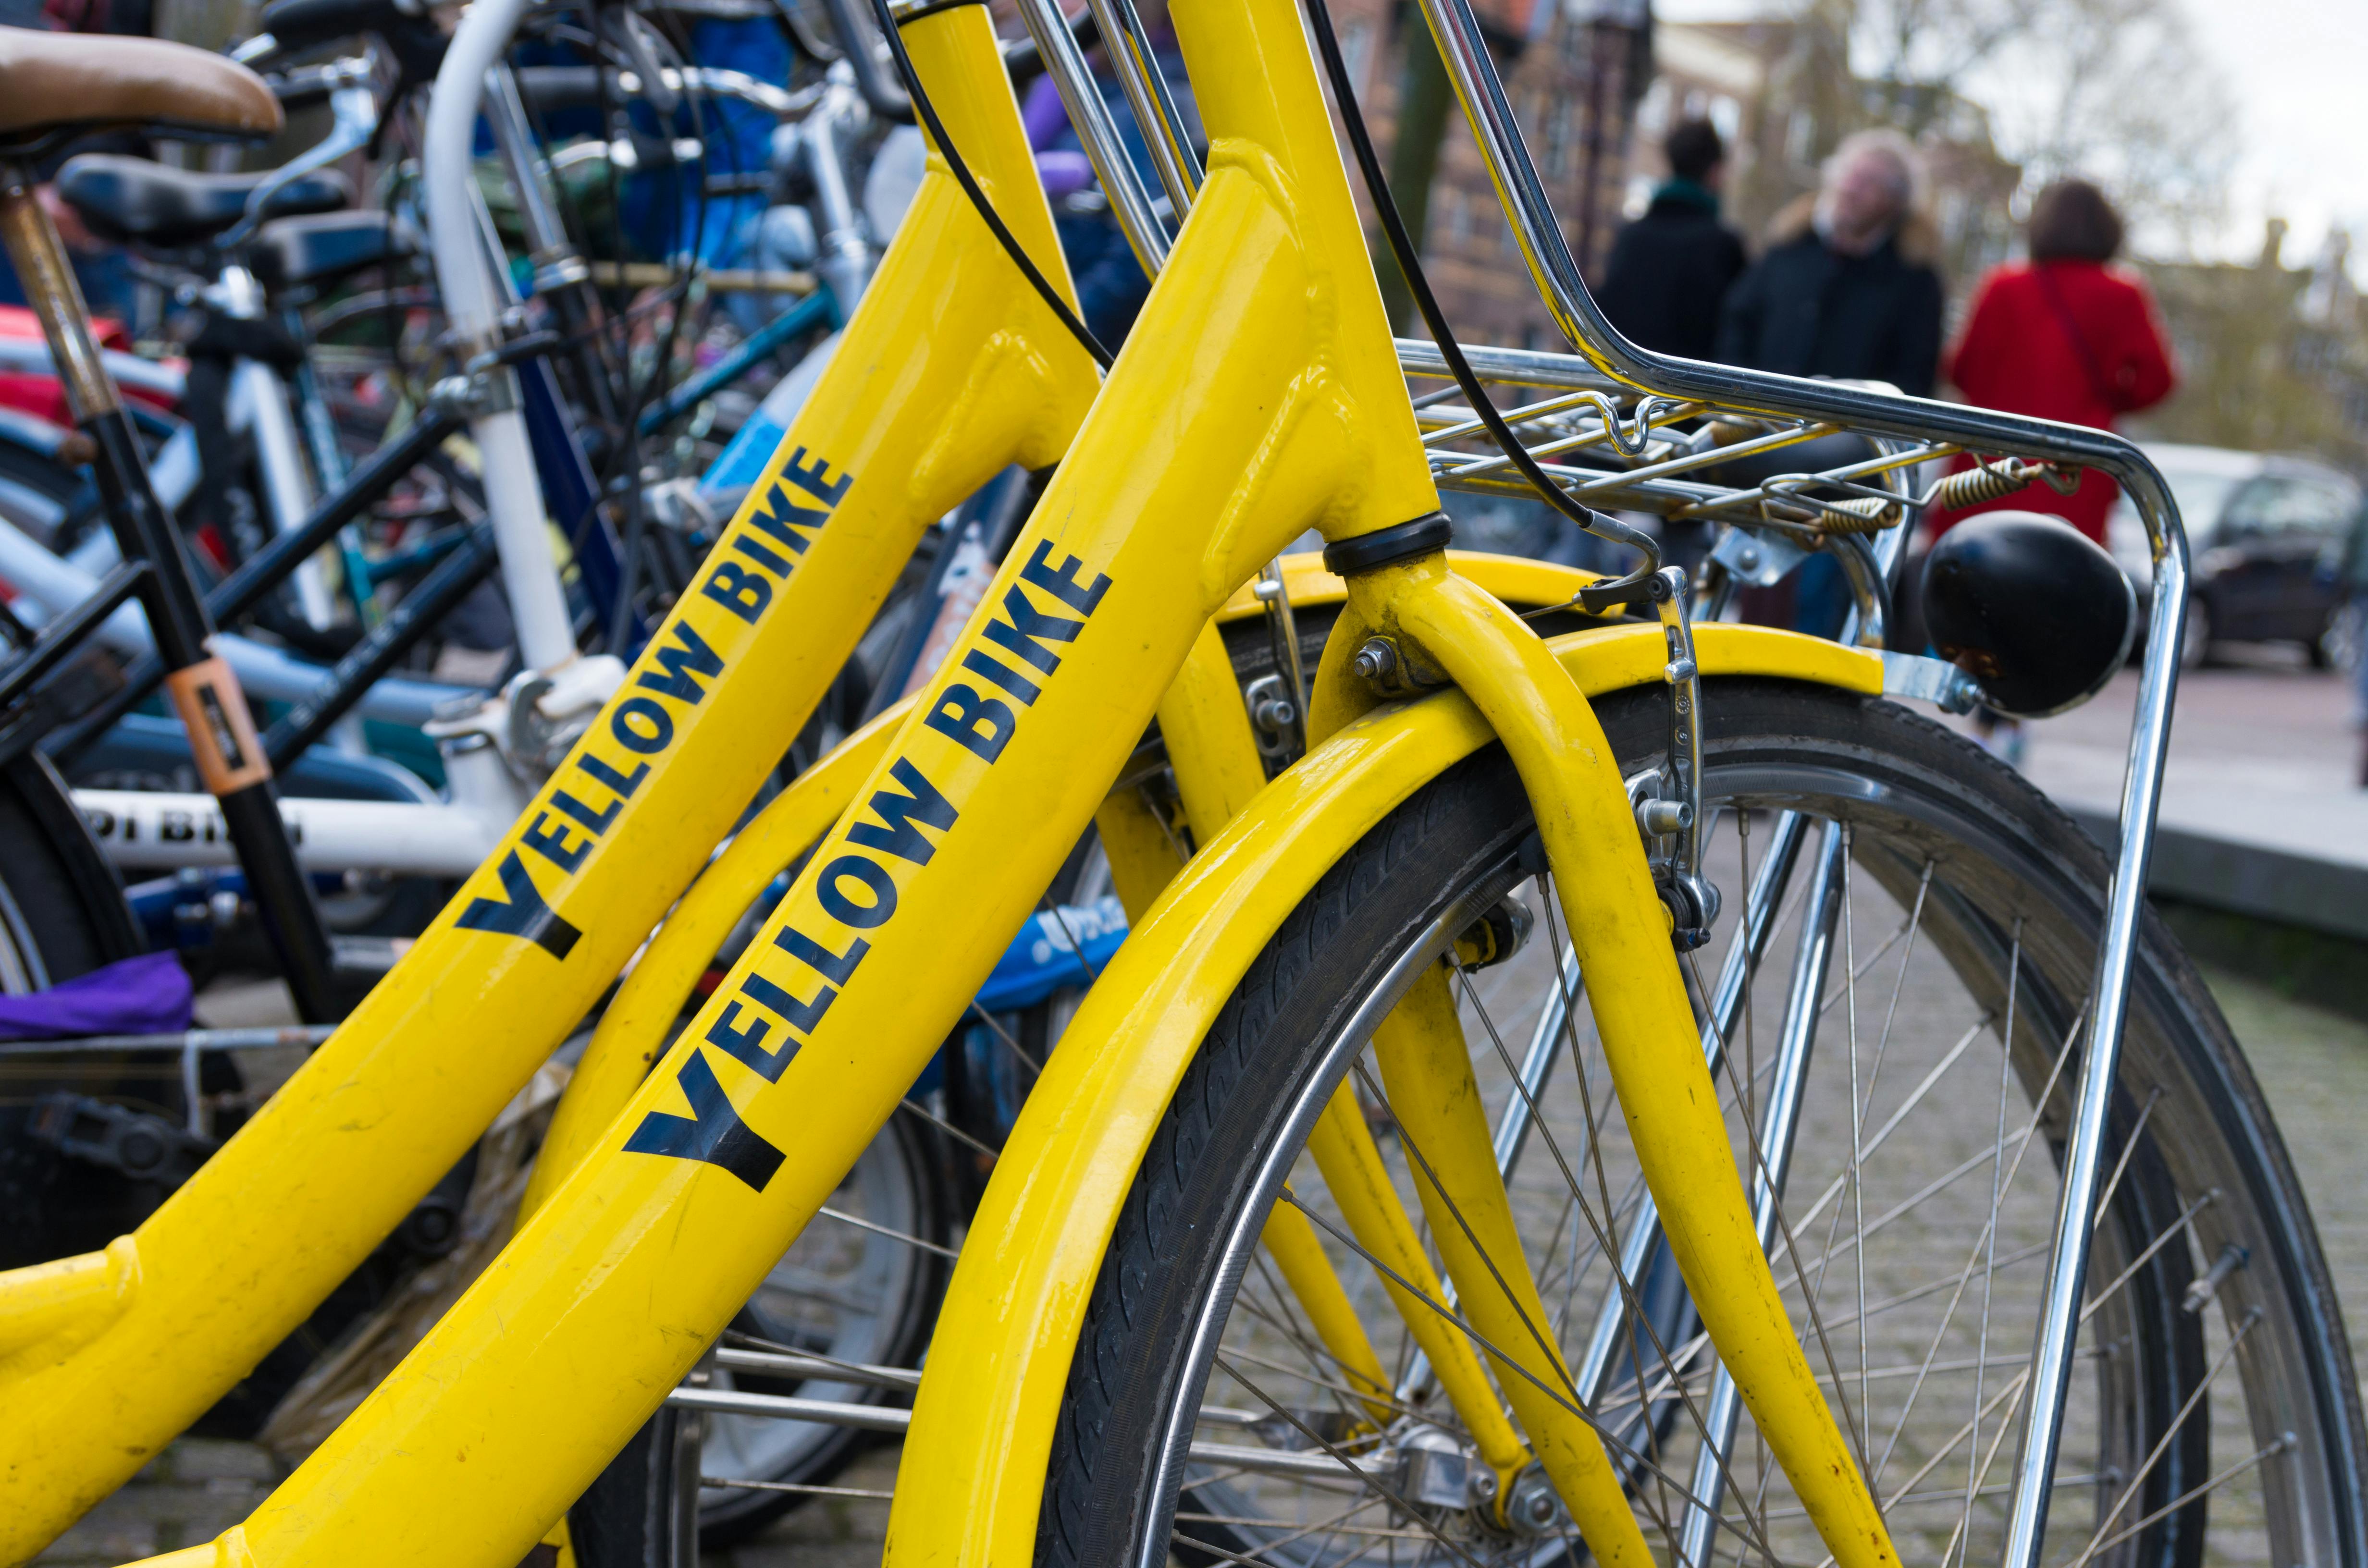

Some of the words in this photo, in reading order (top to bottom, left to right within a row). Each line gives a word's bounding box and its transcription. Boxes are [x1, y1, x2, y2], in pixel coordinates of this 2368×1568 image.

[455, 620, 725, 961] YELLOW
[702, 447, 853, 625] BIKE
[622, 756, 959, 1193] YELLOW
[924, 539, 1113, 765] BIKE
